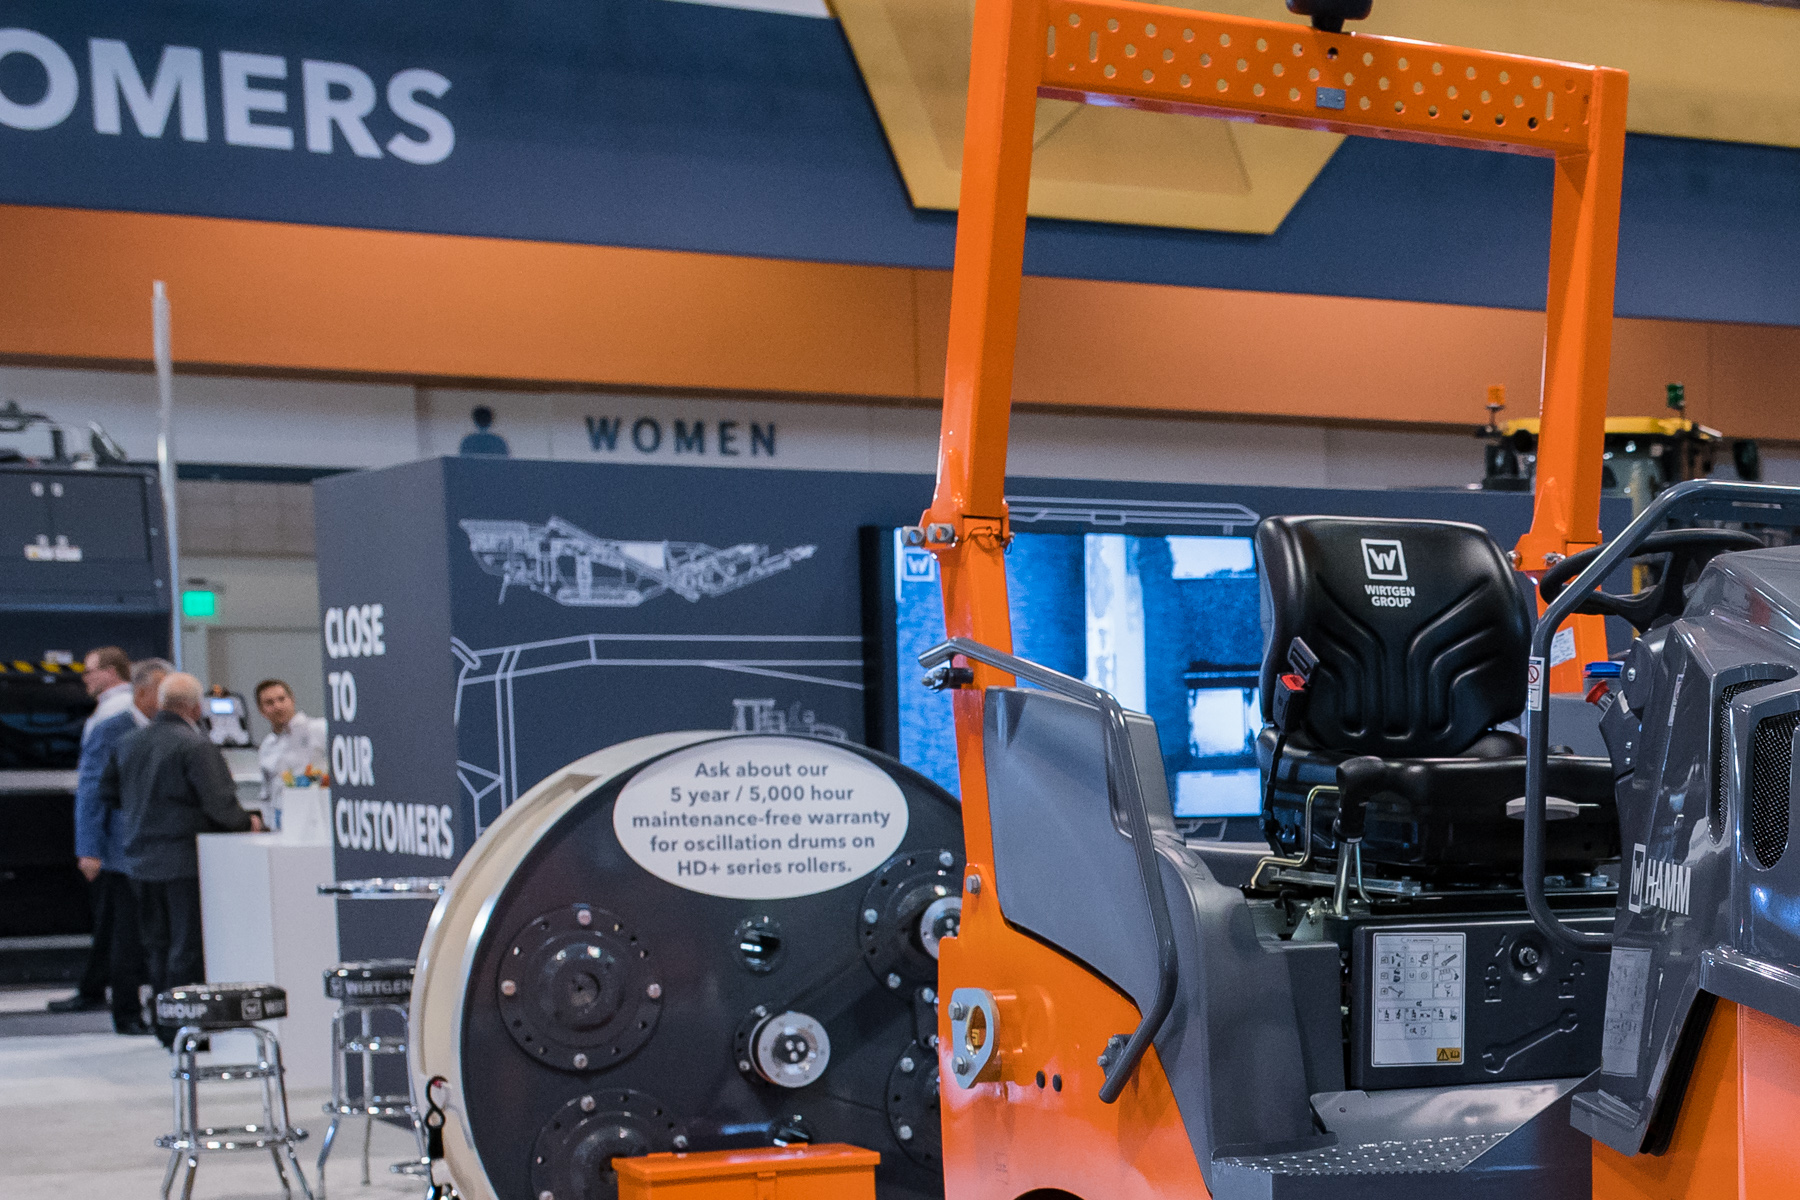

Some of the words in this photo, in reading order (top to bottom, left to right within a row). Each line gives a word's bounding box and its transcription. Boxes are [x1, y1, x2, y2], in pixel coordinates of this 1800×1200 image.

[0, 27, 456, 165] OMERS
[584, 415, 776, 457] WOMEN
[1364, 584, 1416, 597] WIRTGEN
[1371, 596, 1412, 608] GROUP
[325, 603, 386, 659] CLOSE
[328, 671, 357, 722] TO
[332, 735, 375, 787] OUR
[695, 762, 730, 778] Ask
[736, 761, 792, 778] about
[797, 764, 829, 777] our
[670, 787, 682, 802] 5
[688, 788, 730, 806] year
[735, 787, 743, 802] /
[750, 785, 805, 804] 5,000
[811, 786, 854, 801] hour
[335, 798, 455, 860] CUSTOMERS
[632, 809, 802, 828] maintenance-free
[808, 810, 891, 829] warranty
[650, 835, 678, 852] for
[684, 834, 782, 852] oscillation
[787, 833, 847, 850] drums
[852, 836, 875, 849] on
[677, 859, 721, 876] HD+
[726, 859, 782, 875] series
[787, 857, 852, 873] rollers.
[1645, 858, 1692, 916] HAMM
